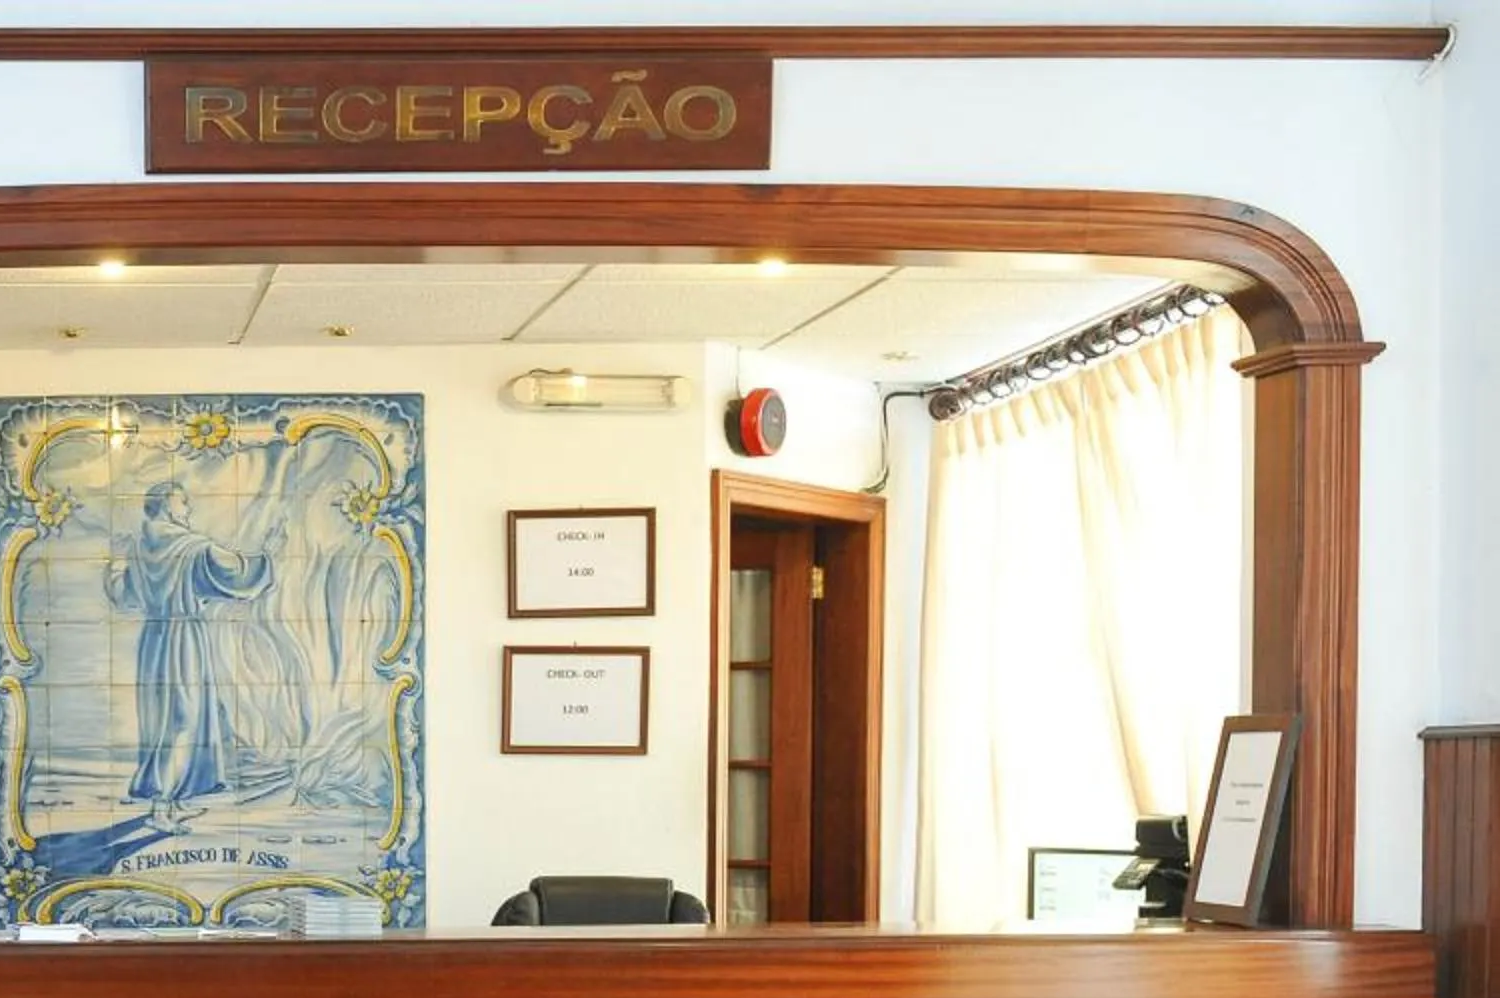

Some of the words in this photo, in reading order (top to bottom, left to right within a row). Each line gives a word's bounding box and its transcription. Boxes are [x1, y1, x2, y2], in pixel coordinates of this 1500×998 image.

[185, 69, 737, 154] RECEPÇÃO
[568, 567, 595, 577] 14:00
[562, 704, 589, 714] 12:00
[137, 848, 217, 871] FRANCISCO
[222, 847, 241, 863] DE
[247, 851, 289, 869] ASSIS
